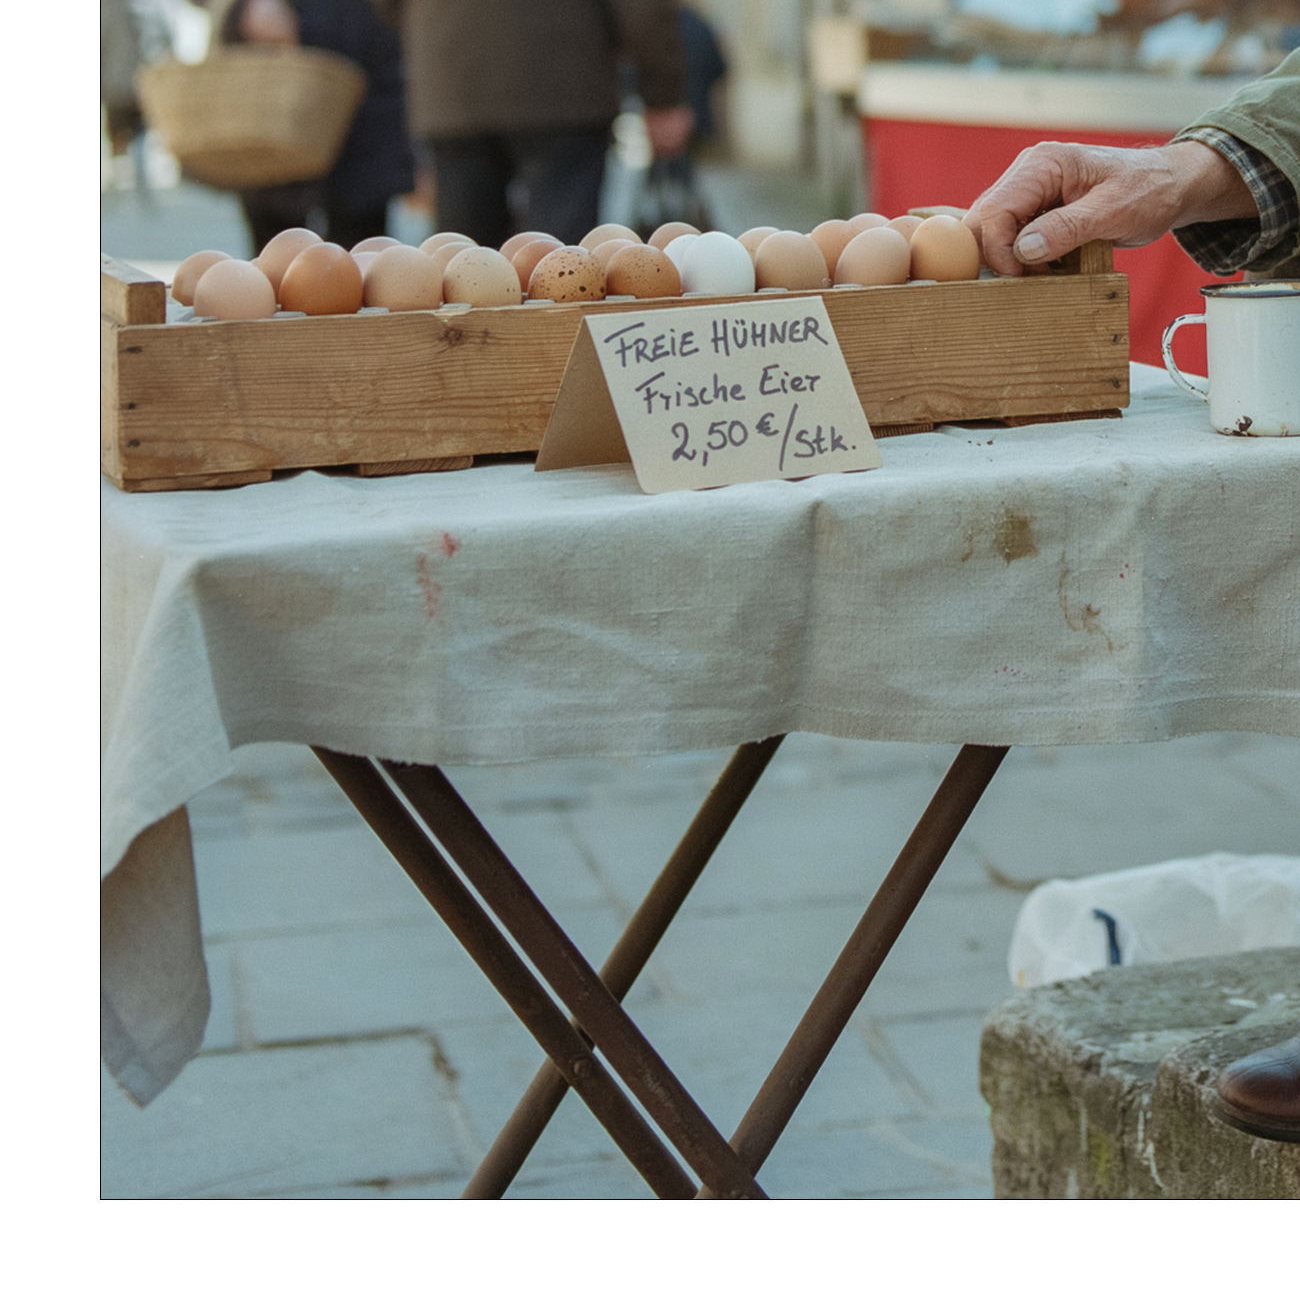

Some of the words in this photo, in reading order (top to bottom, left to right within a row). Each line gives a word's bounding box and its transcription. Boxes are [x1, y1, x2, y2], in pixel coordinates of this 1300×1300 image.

[603, 321, 700, 368] FREIE
[710, 316, 829, 357] HÜHNER
[634, 371, 746, 414] Frische
[758, 363, 821, 396] Eier
